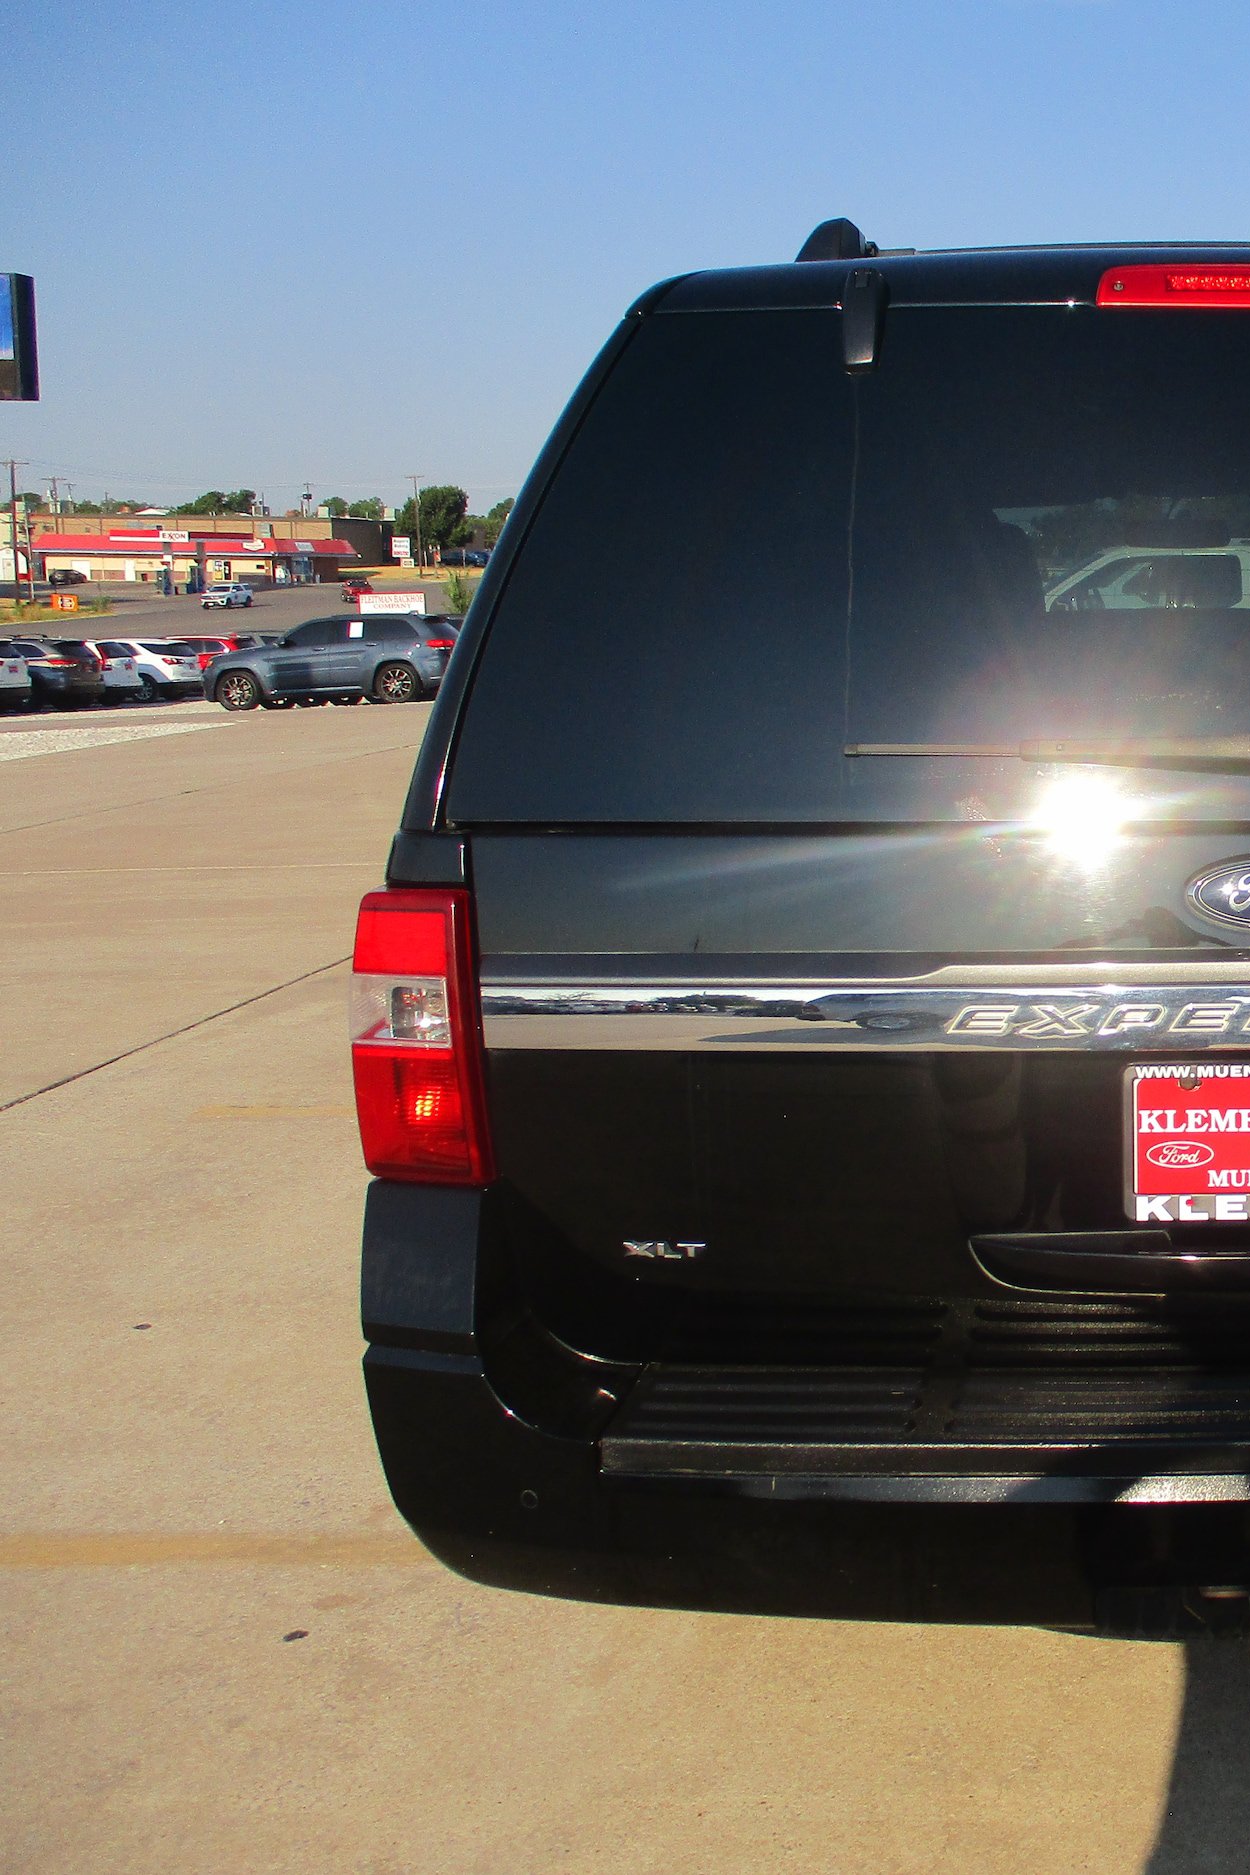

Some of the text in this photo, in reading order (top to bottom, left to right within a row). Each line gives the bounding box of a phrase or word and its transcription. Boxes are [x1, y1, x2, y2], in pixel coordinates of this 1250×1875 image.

[162, 532, 186, 540] EXXON
[1158, 1145, 1201, 1164] Ford
[622, 1240, 707, 1259] XLT
